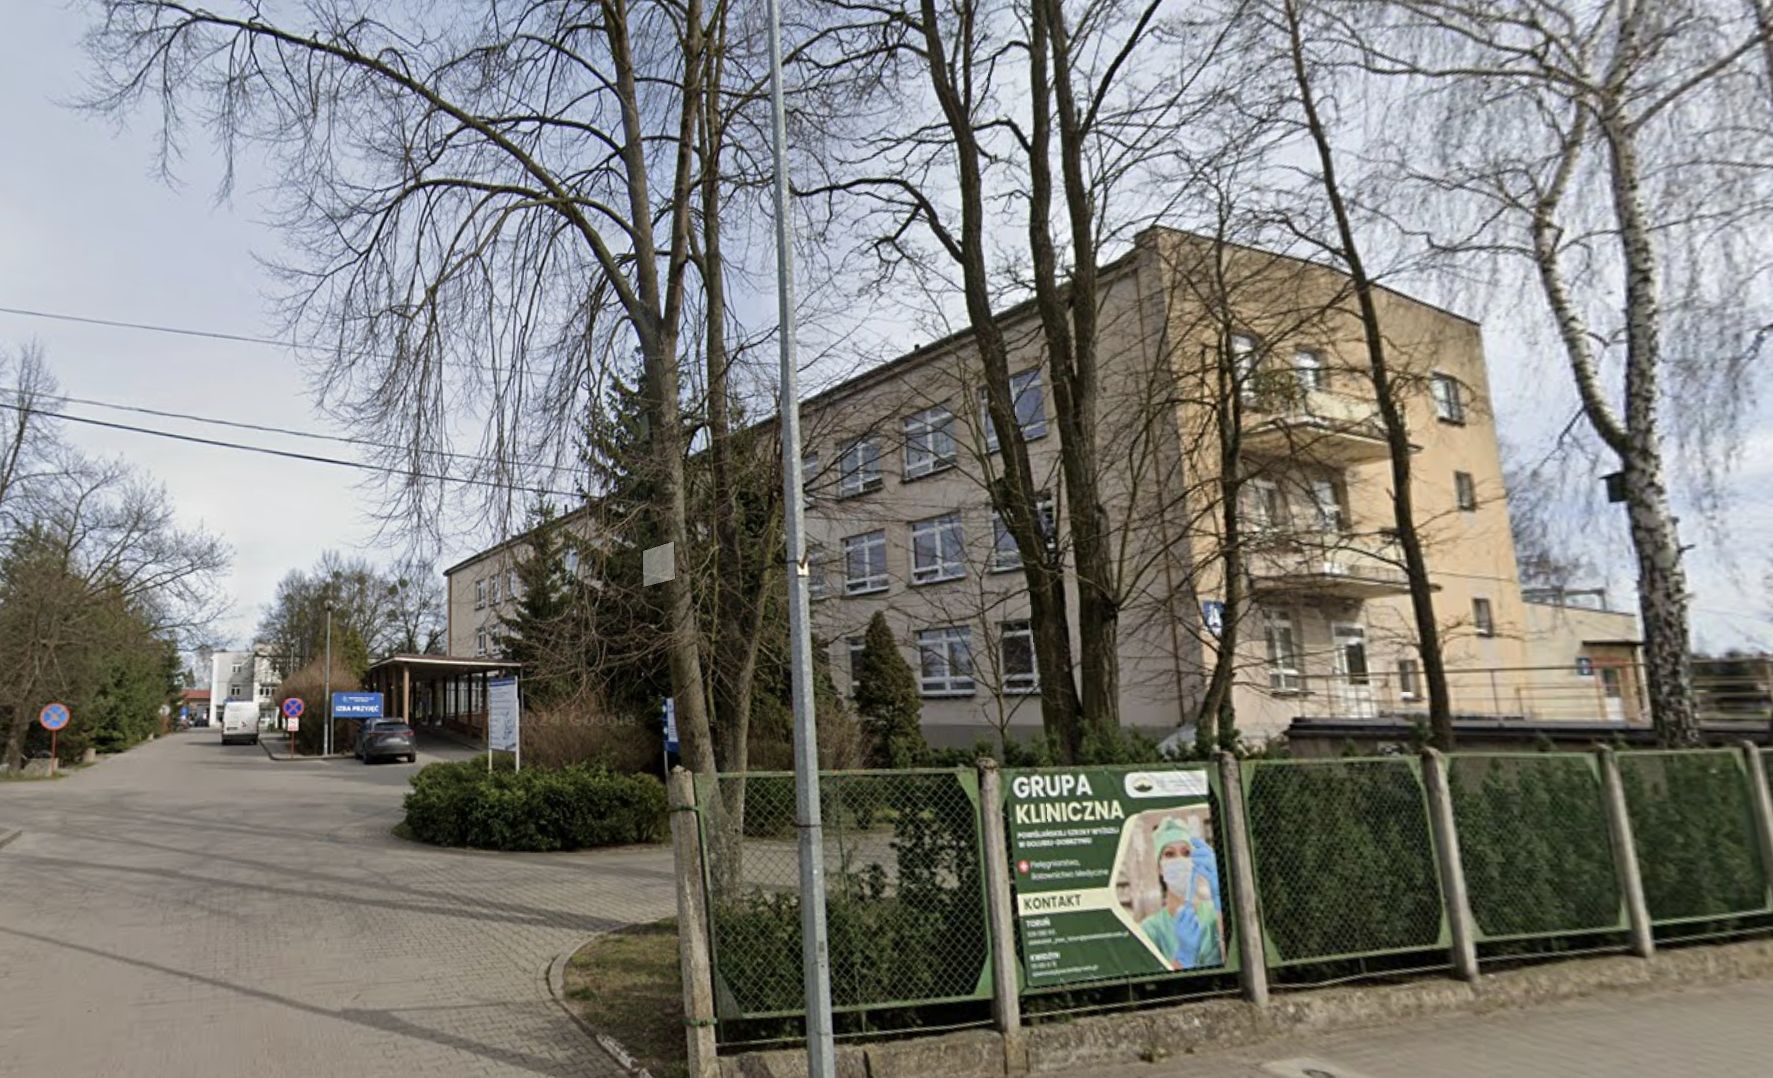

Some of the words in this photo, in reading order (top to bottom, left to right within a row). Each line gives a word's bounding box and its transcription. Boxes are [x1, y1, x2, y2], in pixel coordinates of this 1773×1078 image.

[1013, 774, 1093, 798] GRUPA
[1016, 799, 1125, 824] KLINICZNA
[1023, 894, 1082, 910] KONTAKT
